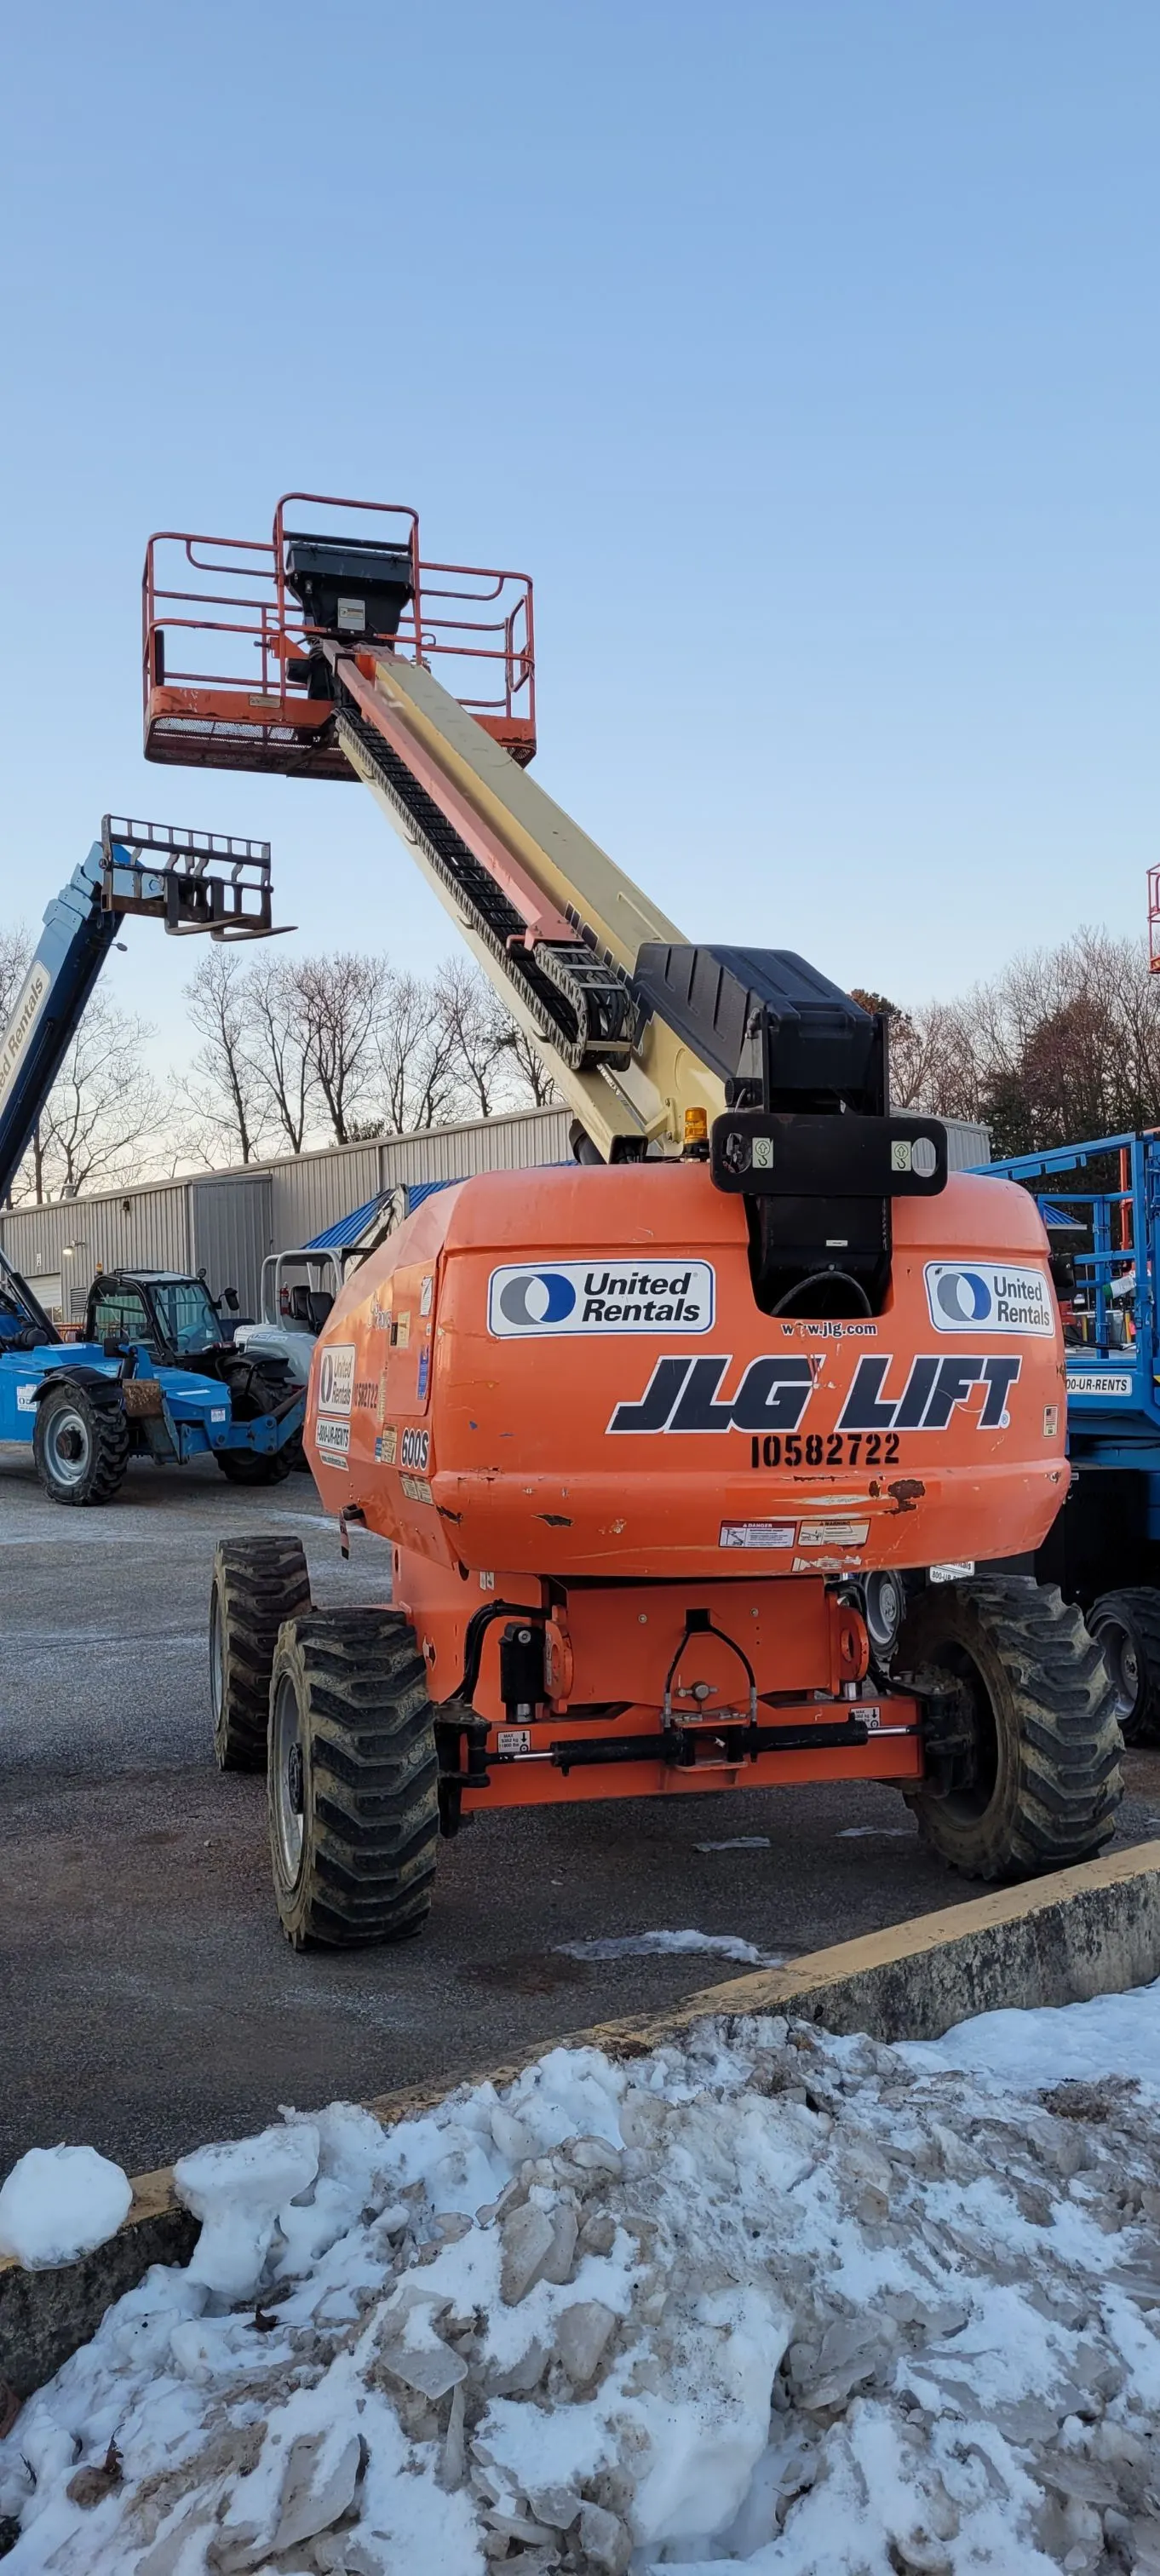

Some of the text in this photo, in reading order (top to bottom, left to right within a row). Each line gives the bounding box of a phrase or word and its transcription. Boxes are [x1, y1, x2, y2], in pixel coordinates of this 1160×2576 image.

[8, 976, 43, 1059] Rentals
[584, 1272, 692, 1296] United
[993, 1275, 1042, 1302] United
[582, 1298, 700, 1322] Rentals
[997, 1300, 1050, 1326] Rentals
[781, 1321, 877, 1338] ww.jlg.com
[333, 1354, 353, 1379] United
[331, 1381, 352, 1406] Rentals
[605, 1354, 1023, 1434] JLG LIFT
[401, 1427, 429, 1470] 600S
[751, 1433, 900, 1468] 10582722
